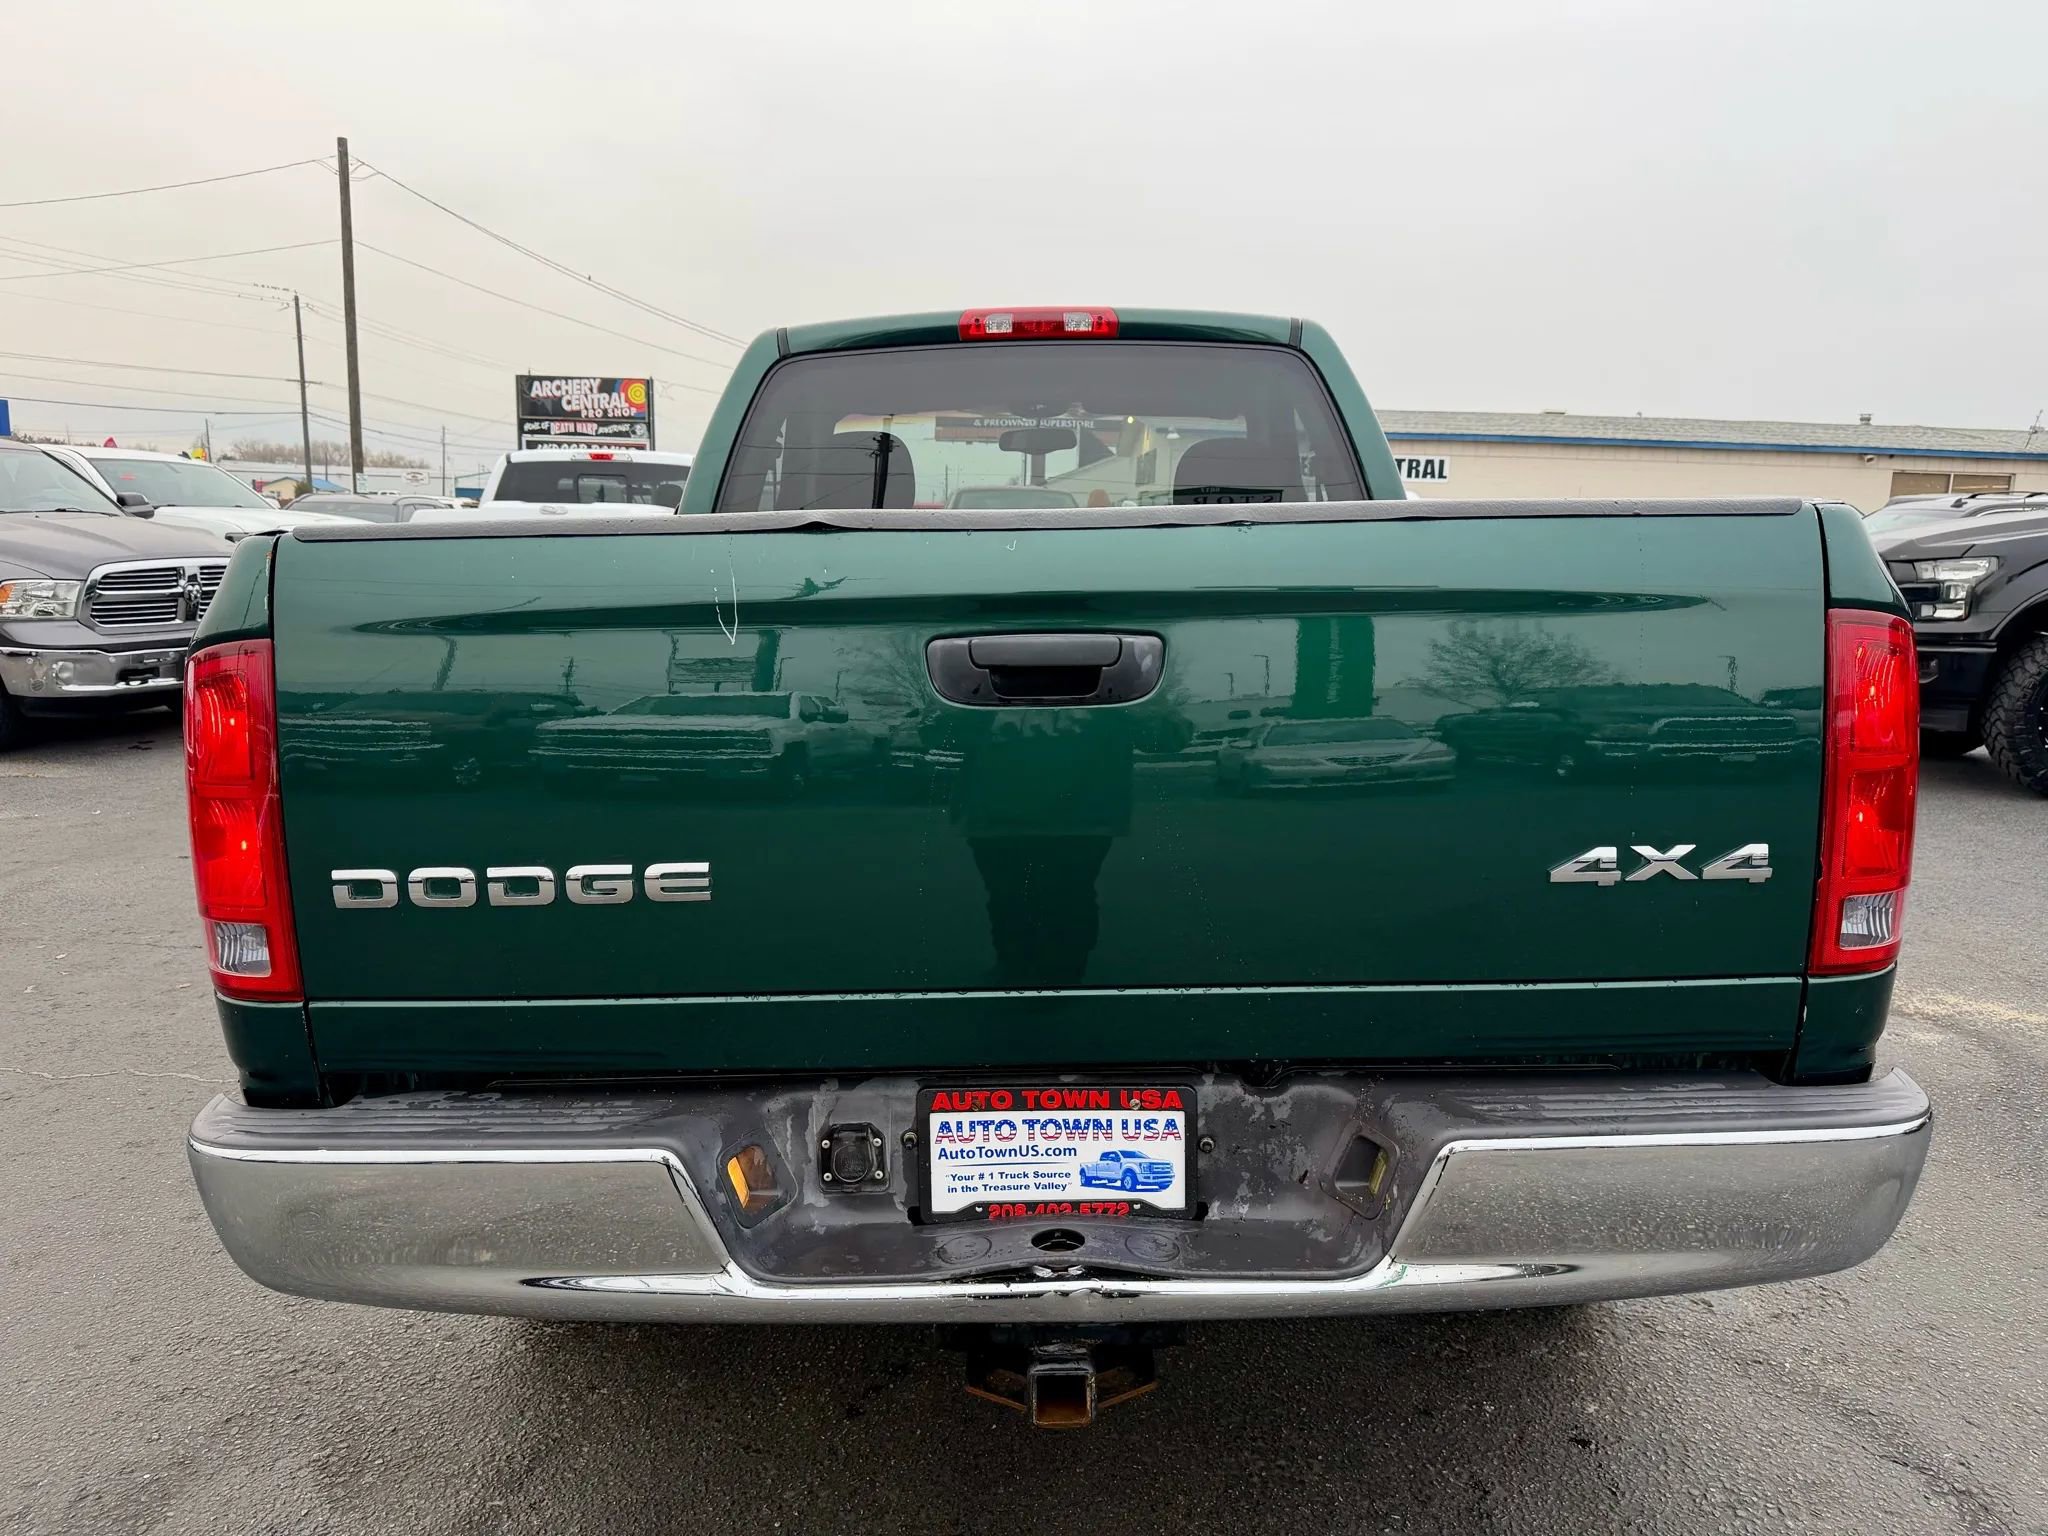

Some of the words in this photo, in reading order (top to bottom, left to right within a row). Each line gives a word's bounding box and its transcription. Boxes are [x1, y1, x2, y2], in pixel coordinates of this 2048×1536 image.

[530, 378, 601, 398] ARCHERY
[561, 392, 629, 412] CENTRAL
[581, 408, 603, 419] PRO
[607, 407, 638, 418] SHOP
[550, 421, 575, 435] DEATH
[576, 421, 598, 436] WARP
[1548, 843, 1773, 886] 4X4
[331, 862, 712, 909] DODGE
[931, 1089, 1014, 1111] AUTO
[1021, 1088, 1110, 1110] TOWN
[1120, 1089, 1183, 1110] USA
[935, 1119, 1017, 1144] AUTO
[1022, 1118, 1113, 1141] TOWN
[1121, 1118, 1182, 1141] USA
[937, 1144, 1077, 1160] AutoTownUS.com
[978, 1172, 985, 1181] #
[988, 1172, 994, 1180] 1
[998, 1171, 1030, 1180] Truck
[1032, 1170, 1072, 1179] Source
[947, 1185, 957, 1193] in
[961, 1184, 979, 1193] the
[981, 1183, 1031, 1192] Treasure
